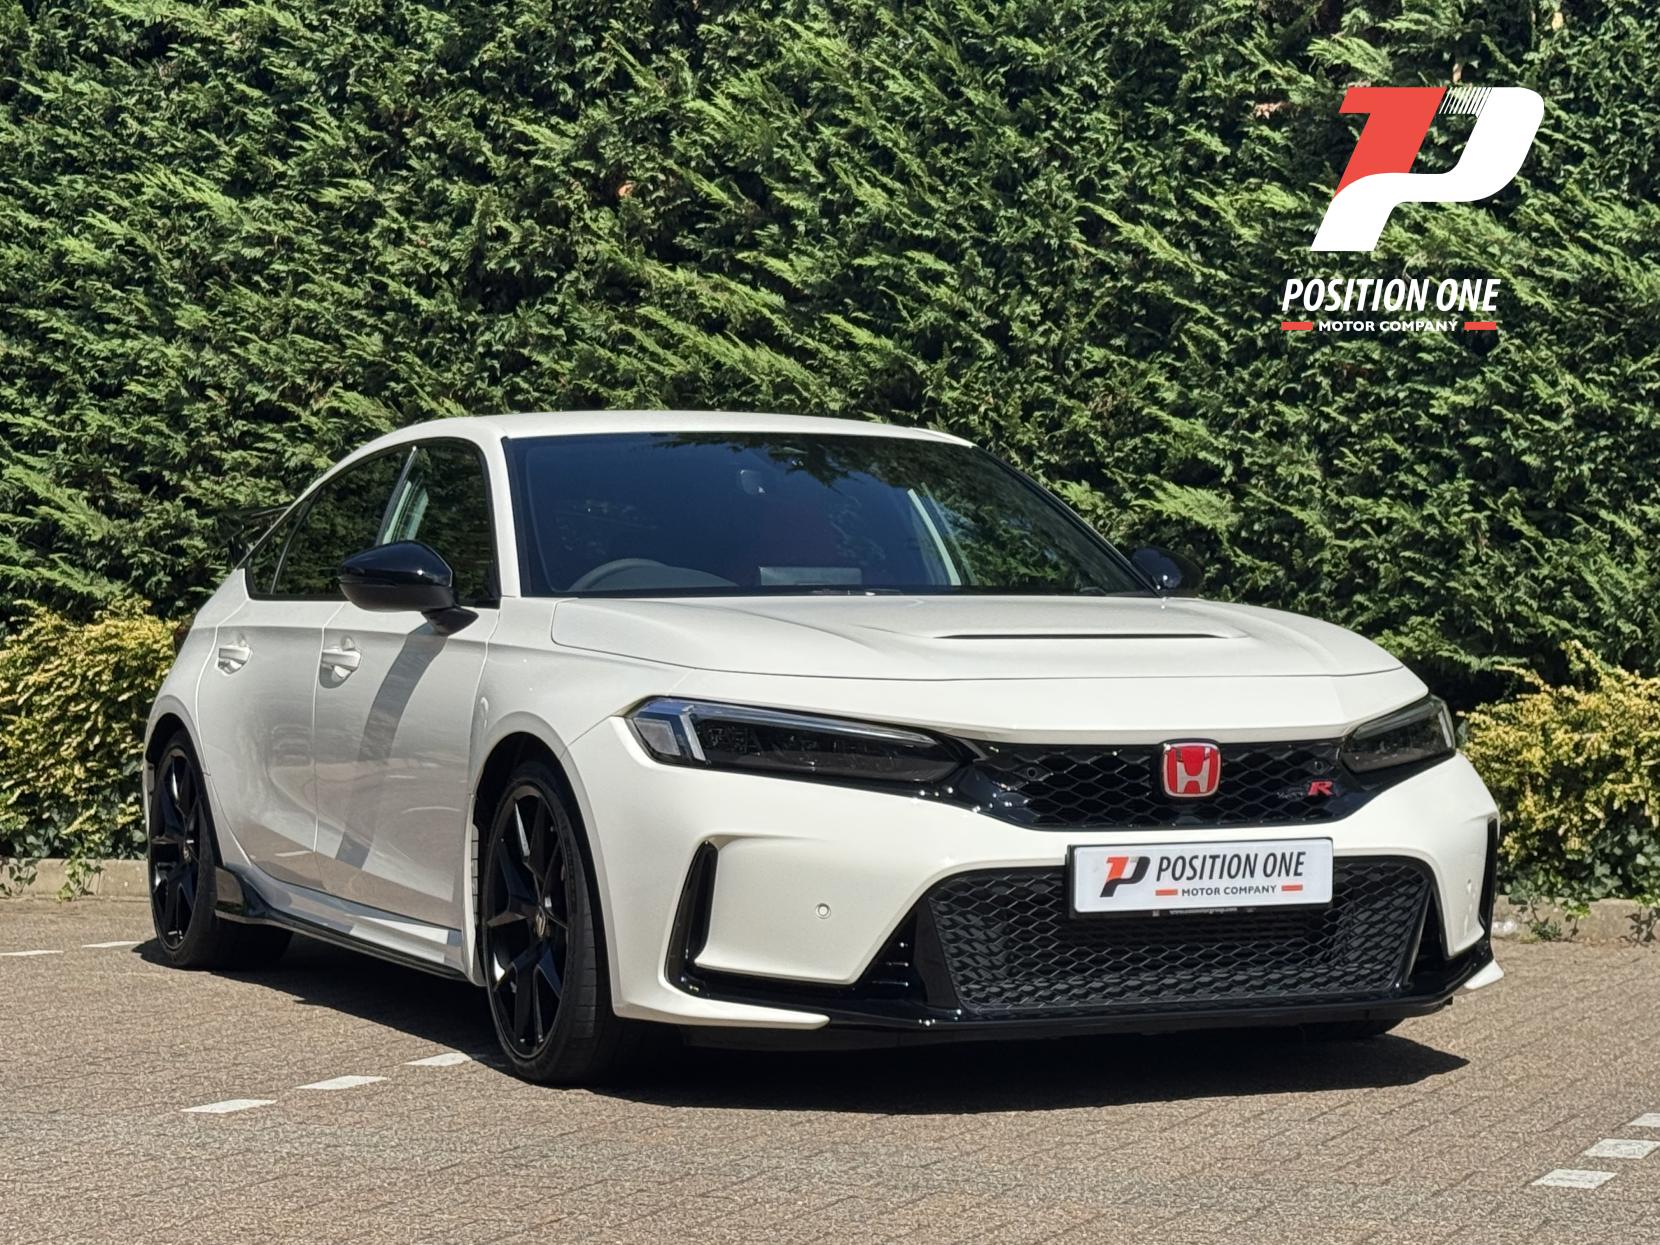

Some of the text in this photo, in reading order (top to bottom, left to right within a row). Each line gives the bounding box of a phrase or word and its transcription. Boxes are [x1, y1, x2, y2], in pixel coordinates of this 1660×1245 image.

[1307, 780, 1333, 796] R
[1156, 851, 1306, 882] POSITION ONE
[1181, 884, 1277, 897] MOTOR COMPANY
